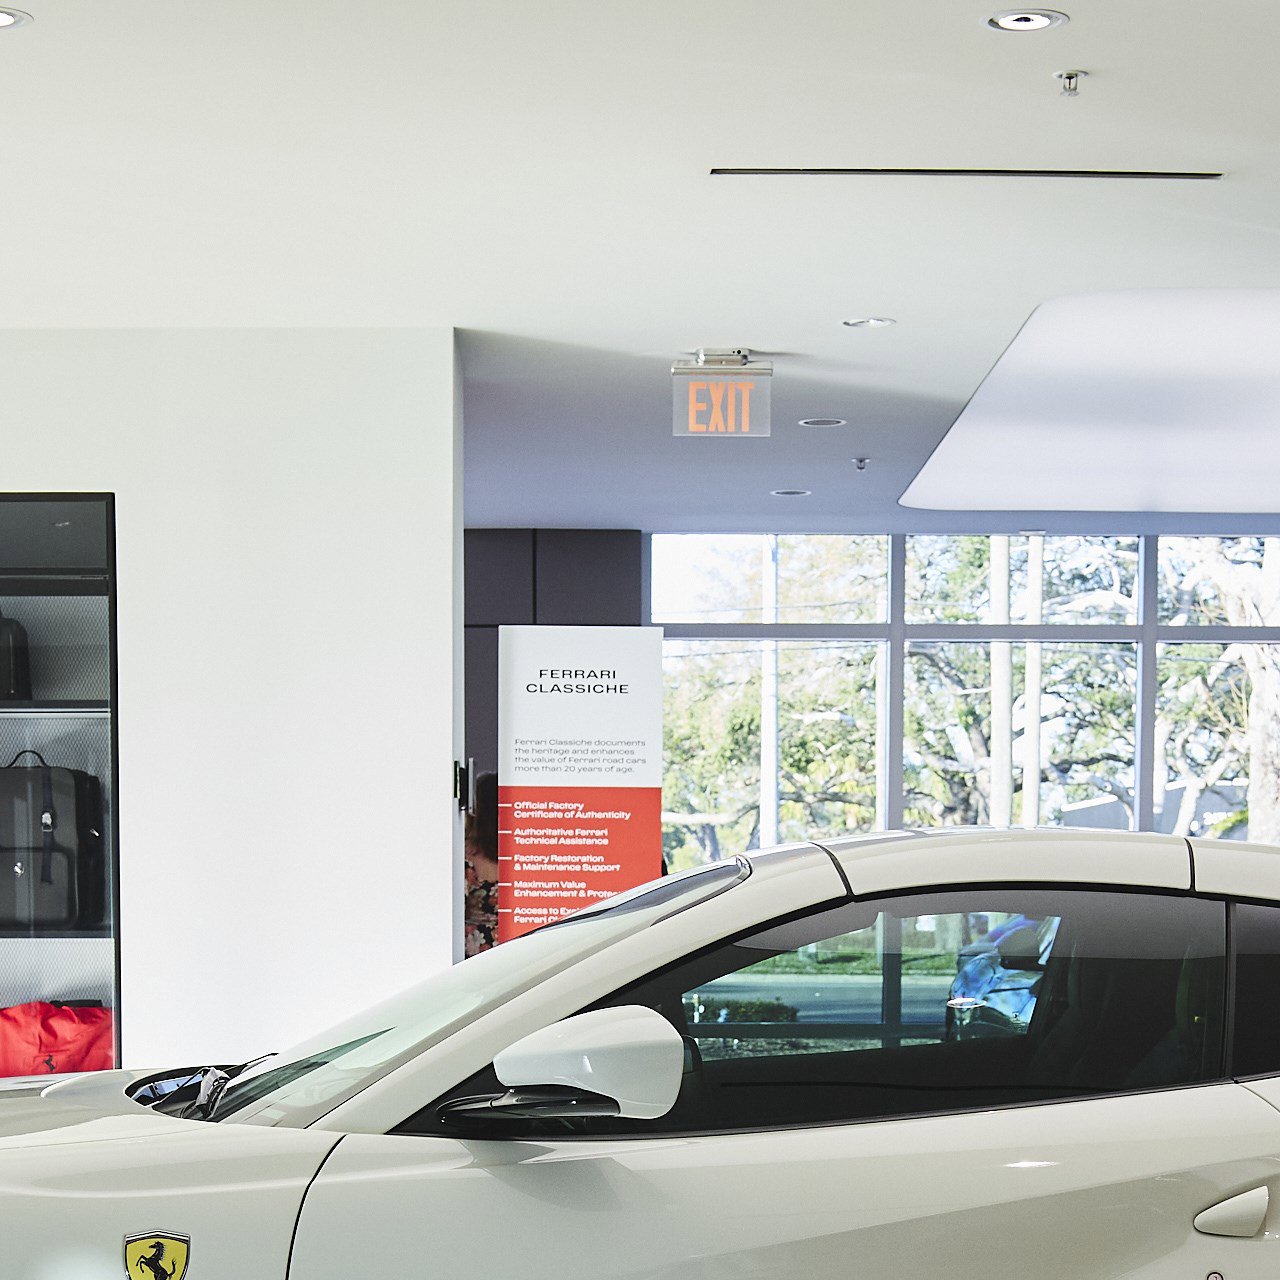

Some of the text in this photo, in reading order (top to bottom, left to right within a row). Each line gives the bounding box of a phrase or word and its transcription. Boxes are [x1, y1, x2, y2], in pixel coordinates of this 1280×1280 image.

[688, 381, 755, 433] EXIT
[539, 669, 616, 679] FERRARI
[526, 683, 629, 694] CLASSICHE
[514, 739, 646, 747] Ferrari Classiche documents
[514, 747, 530, 755] the
[531, 747, 570, 756] heritage
[558, 756, 568, 764] of
[569, 756, 601, 764] Ferrari
[541, 765, 562, 773] than
[564, 765, 576, 773] 20
[577, 766, 603, 774] years
[513, 801, 584, 811] Official Factory
[513, 810, 631, 820] Certificate of Authenticity
[513, 827, 608, 836] Authoritative Ferrari
[514, 837, 609, 845] Technical Assistance
[513, 854, 605, 863] Factory Restoration
[513, 863, 621, 873] & Maintenance Support
[513, 880, 587, 889] Maximum Value
[513, 889, 577, 898] Enhancement
[579, 889, 587, 897] &
[513, 907, 548, 915] Access
[548, 907, 559, 915] to
[513, 915, 547, 924] Ferrari
